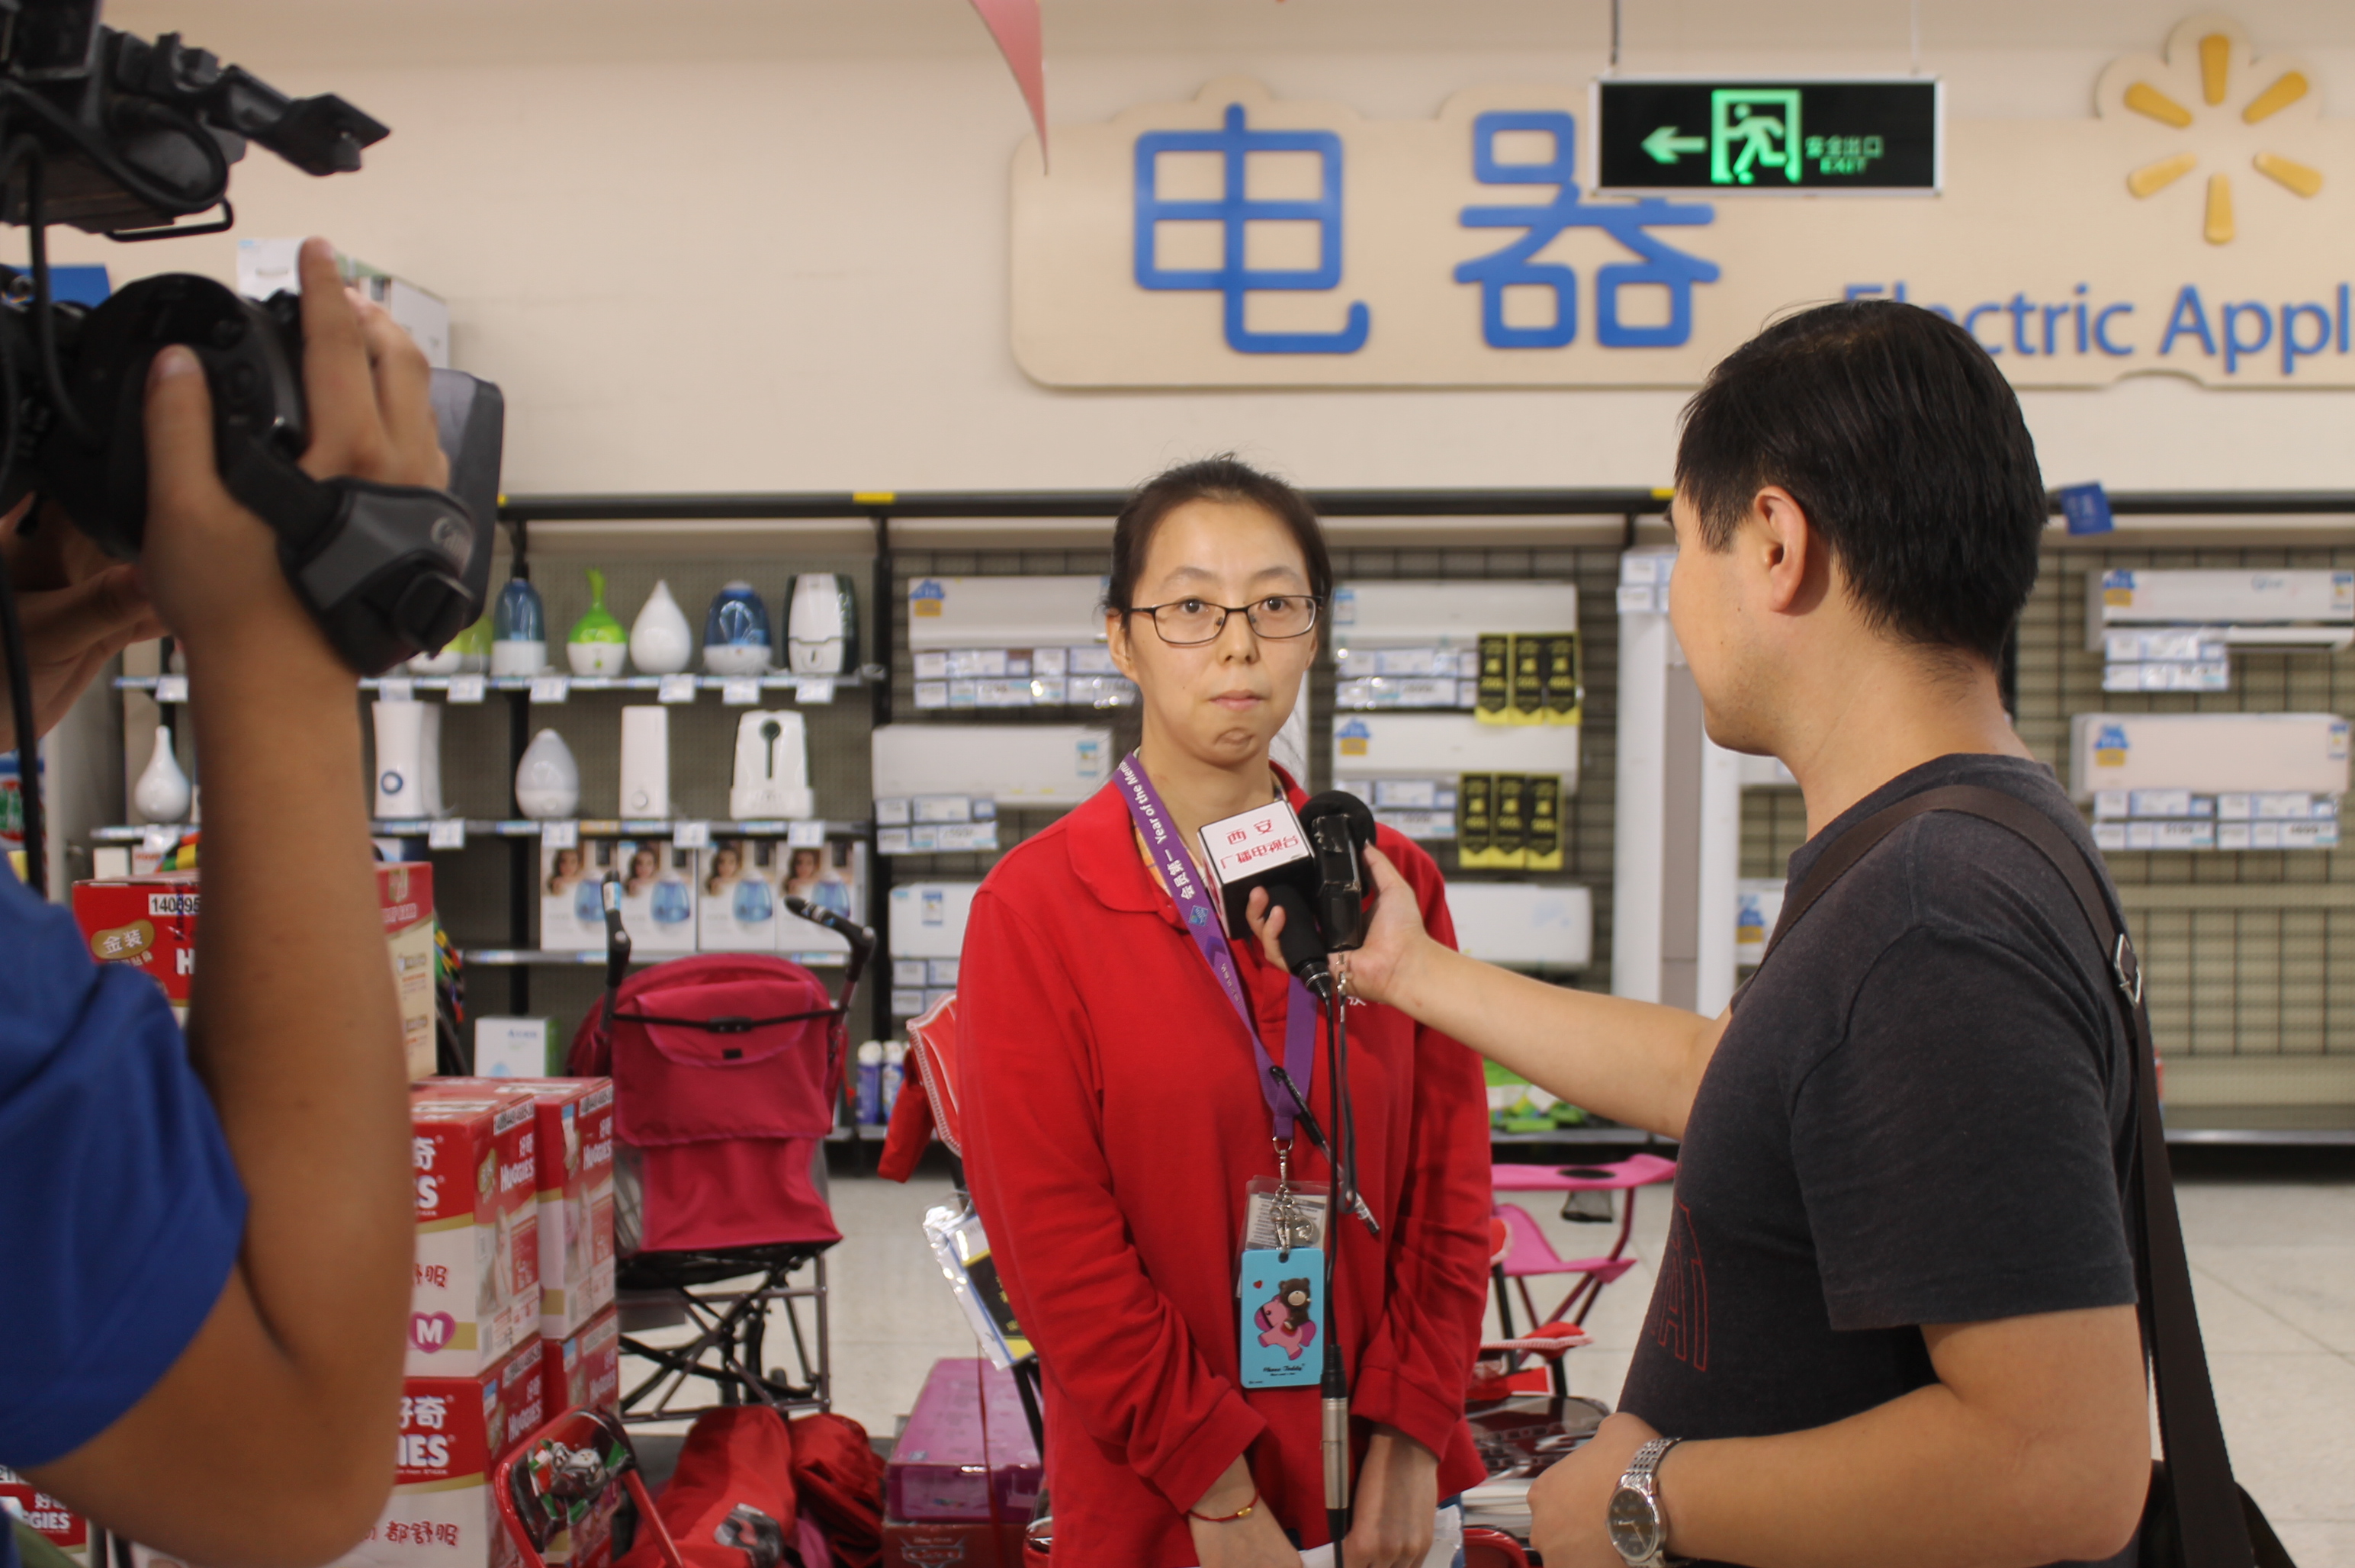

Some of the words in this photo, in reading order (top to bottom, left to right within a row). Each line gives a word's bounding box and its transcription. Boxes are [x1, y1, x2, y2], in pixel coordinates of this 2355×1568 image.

[1133, 101, 1720, 354] 电器
[1846, 281, 2134, 355] ctric
[2160, 283, 2350, 376] Appl
[1133, 784, 1149, 805] the
[1139, 803, 1155, 817] of
[1149, 818, 1168, 845] Year
[1226, 819, 1274, 845] 西安
[1220, 835, 1299, 869] 广播电视台
[102, 928, 143, 955] 金装
[415, 1174, 439, 1210] S
[416, 1318, 444, 1345] M
[384, 1520, 459, 1547] 都舒服
